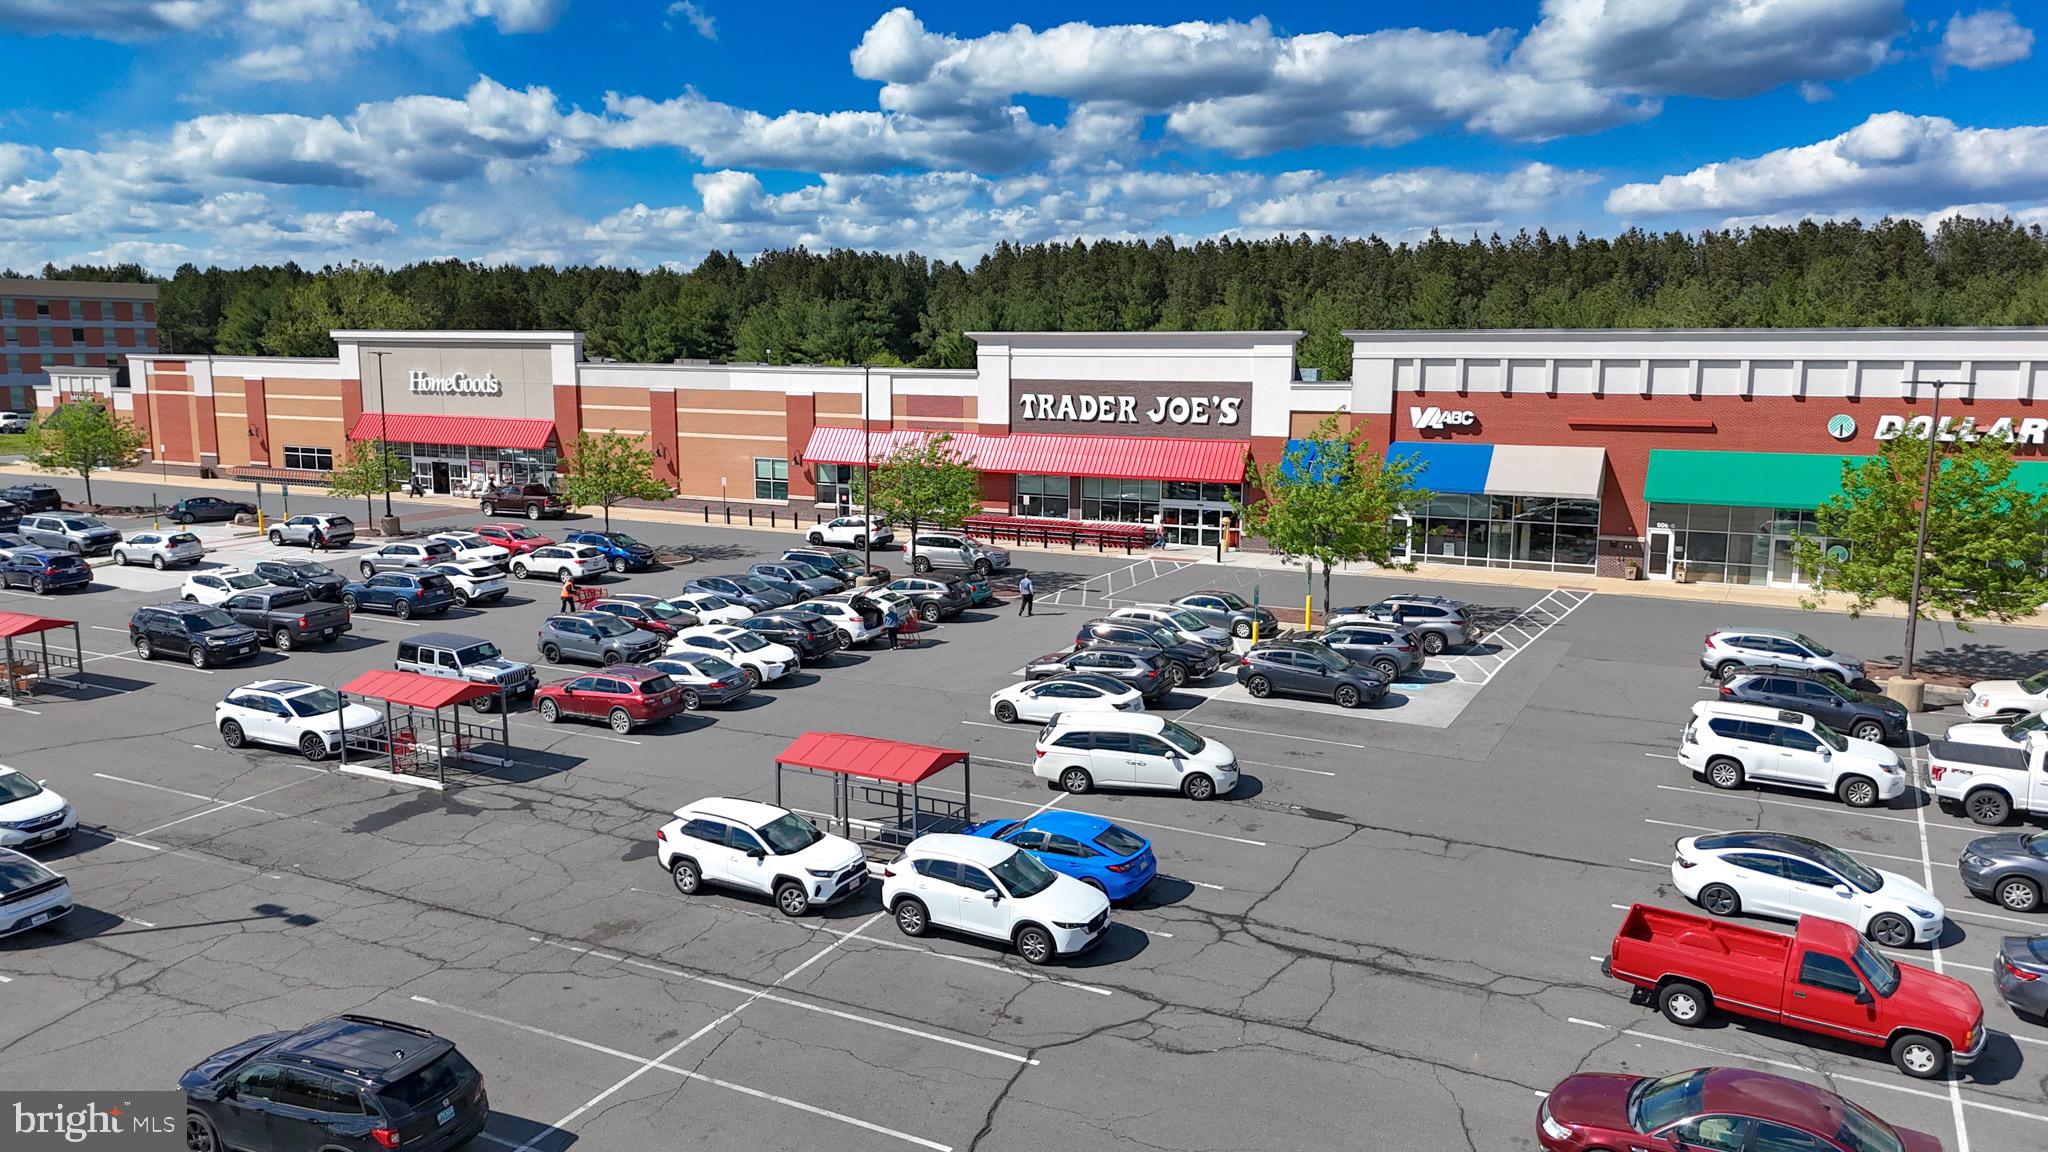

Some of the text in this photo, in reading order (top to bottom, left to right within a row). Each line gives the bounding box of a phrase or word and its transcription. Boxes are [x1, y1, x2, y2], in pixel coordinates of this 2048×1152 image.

[408, 369, 499, 393] HomeGoods
[1019, 392, 1242, 426] TRADER JOE'S
[1439, 410, 1474, 425] ABC
[1873, 414, 2048, 444] DOLLAR
